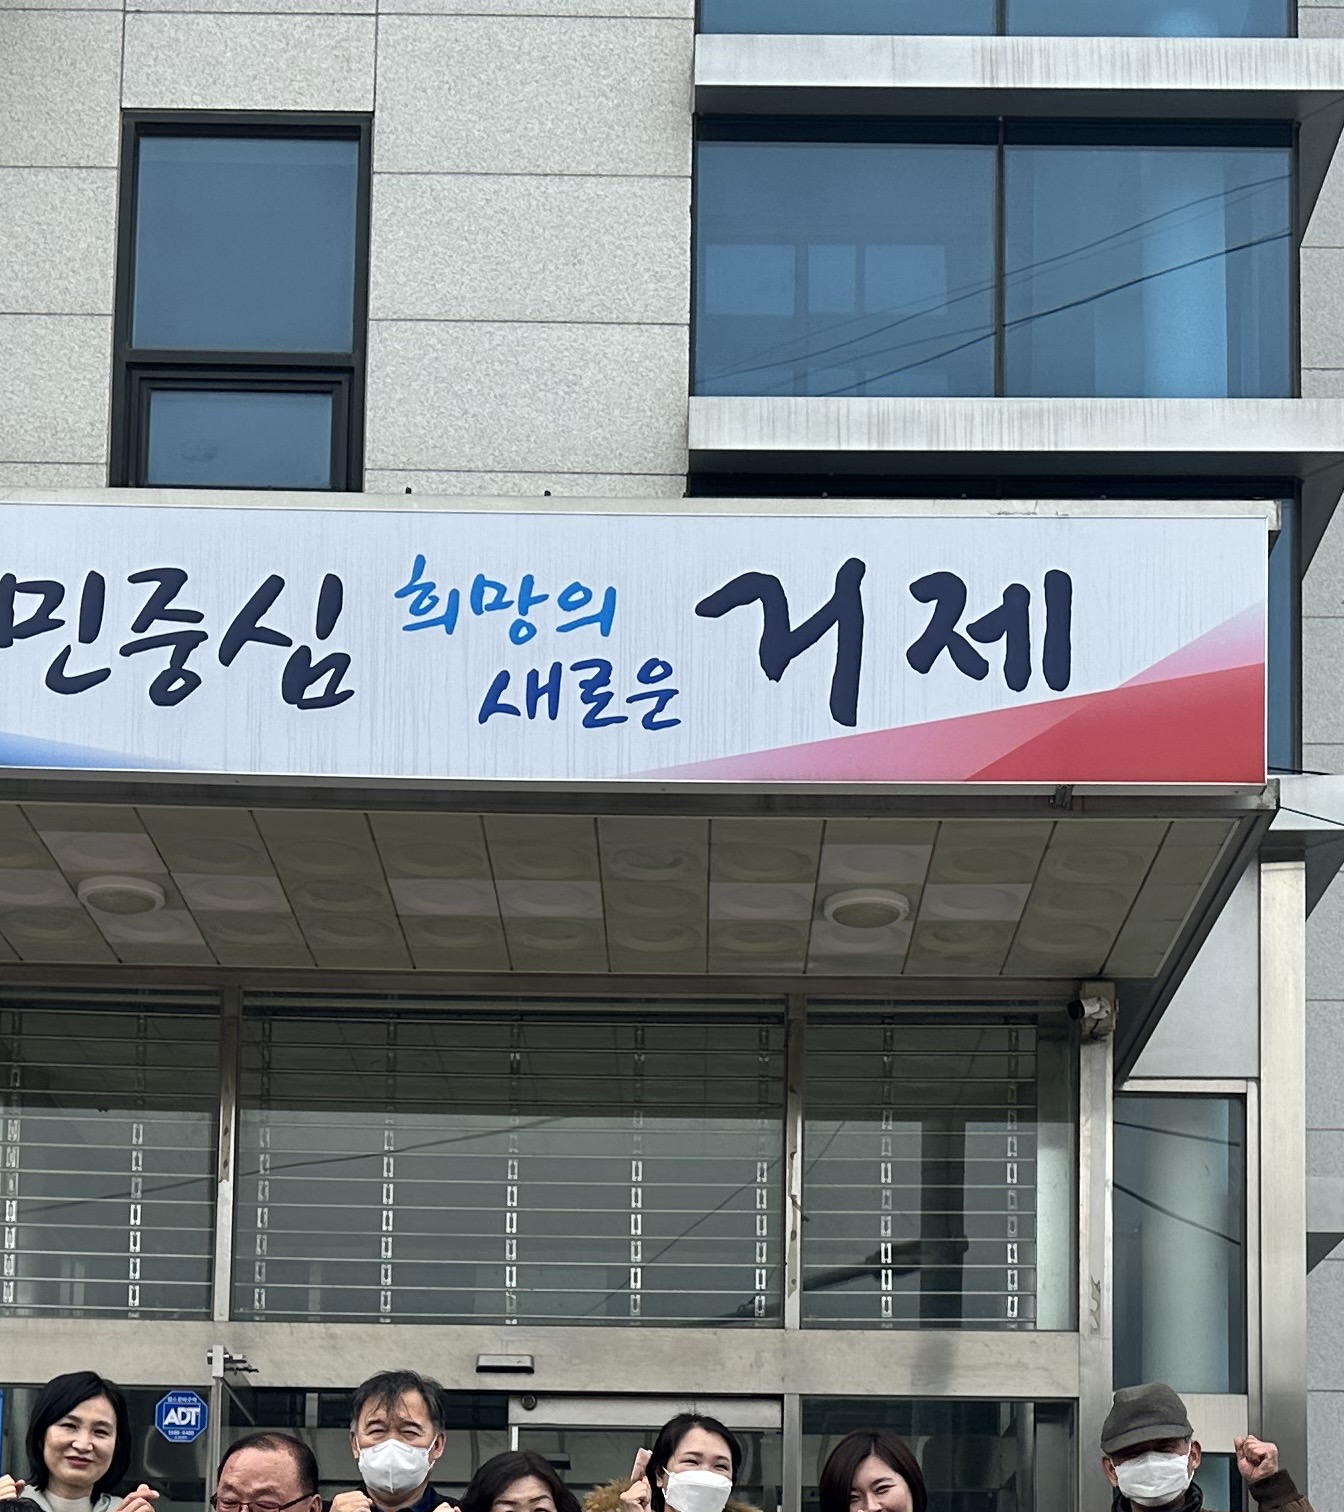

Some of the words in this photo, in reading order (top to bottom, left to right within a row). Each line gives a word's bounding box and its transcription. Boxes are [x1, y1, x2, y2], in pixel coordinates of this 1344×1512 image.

[394, 554, 616, 646] 희망의
[695, 556, 1072, 728] 거제
[478, 656, 682, 731] 새로운
[163, 1406, 200, 1426] ADT
